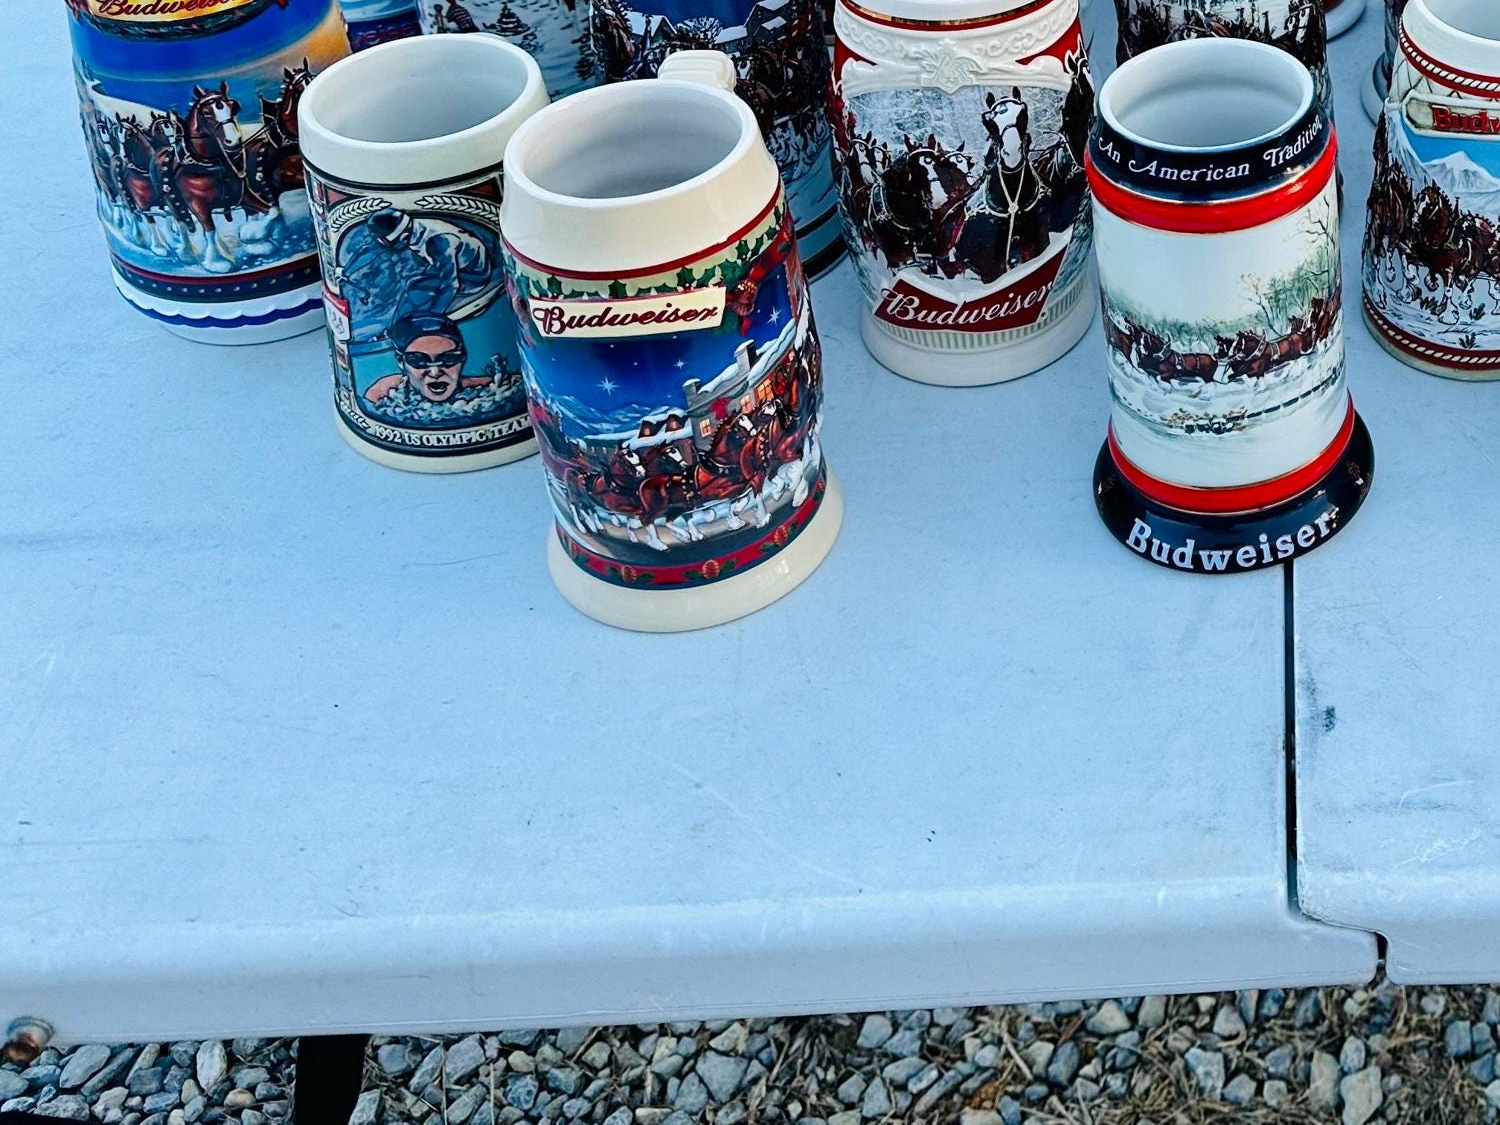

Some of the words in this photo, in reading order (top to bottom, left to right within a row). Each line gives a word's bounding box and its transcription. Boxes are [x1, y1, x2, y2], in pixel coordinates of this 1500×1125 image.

[1099, 135, 1121, 162] An
[1128, 157, 1250, 183] American
[1263, 114, 1323, 167] Tradition
[532, 302, 719, 335] Budweiser
[881, 279, 1054, 326] Budweiser
[375, 424, 401, 442] 1992
[422, 429, 486, 446] OLYMPIC
[490, 416, 531, 439] TEAM
[1125, 512, 1332, 572] Budweiser
